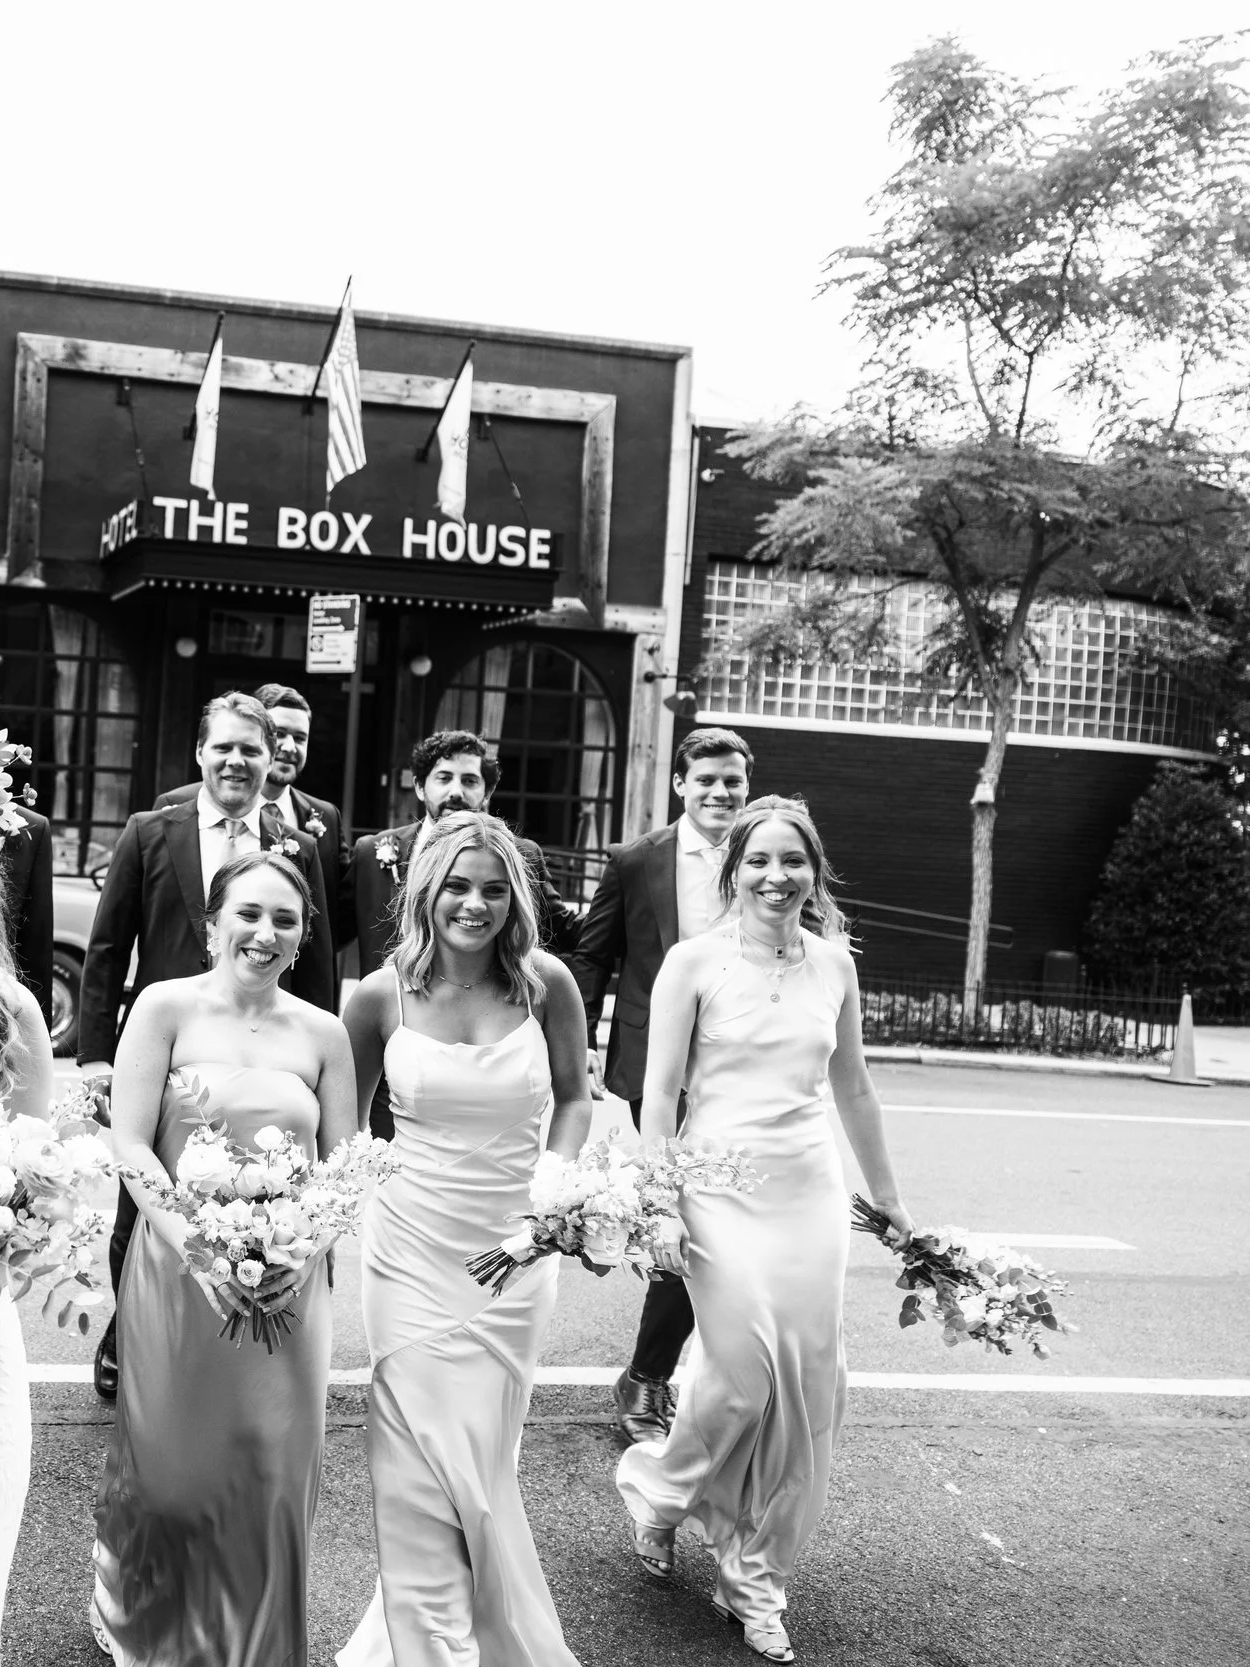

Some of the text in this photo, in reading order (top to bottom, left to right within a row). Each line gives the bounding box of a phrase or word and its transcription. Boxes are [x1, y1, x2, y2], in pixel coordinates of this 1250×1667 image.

[100, 498, 138, 559] HOTEL
[152, 495, 551, 569] THE BOX HOUSE
